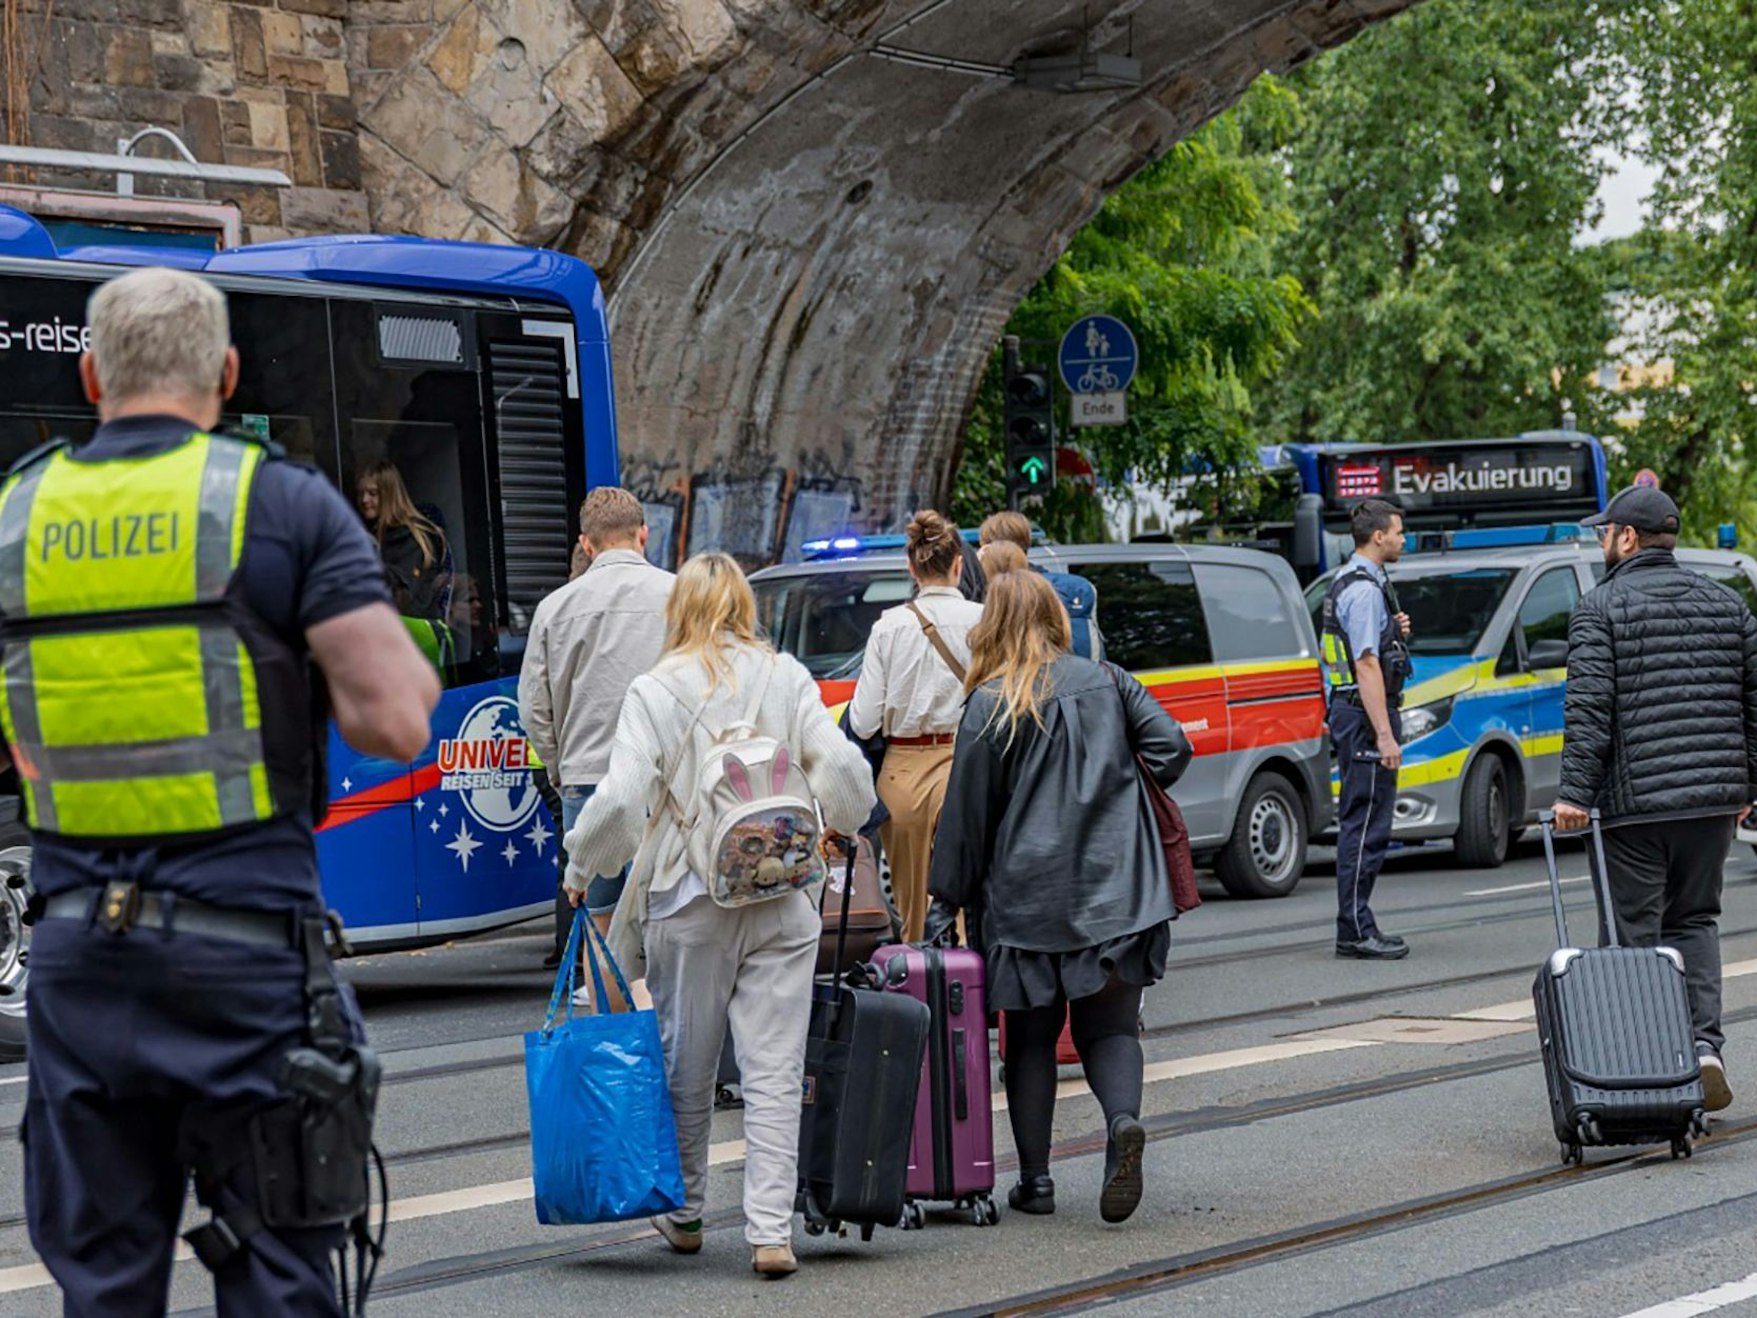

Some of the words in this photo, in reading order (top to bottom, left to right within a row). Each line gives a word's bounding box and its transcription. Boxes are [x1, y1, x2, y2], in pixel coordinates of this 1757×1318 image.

[1082, 402, 1114, 416] Ende
[1394, 461, 1572, 494] Evakuierung
[41, 511, 179, 563] POLIZEI
[438, 739, 529, 772] UNIVE
[441, 772, 491, 791] REISEN
[493, 771, 524, 789] SEIT
